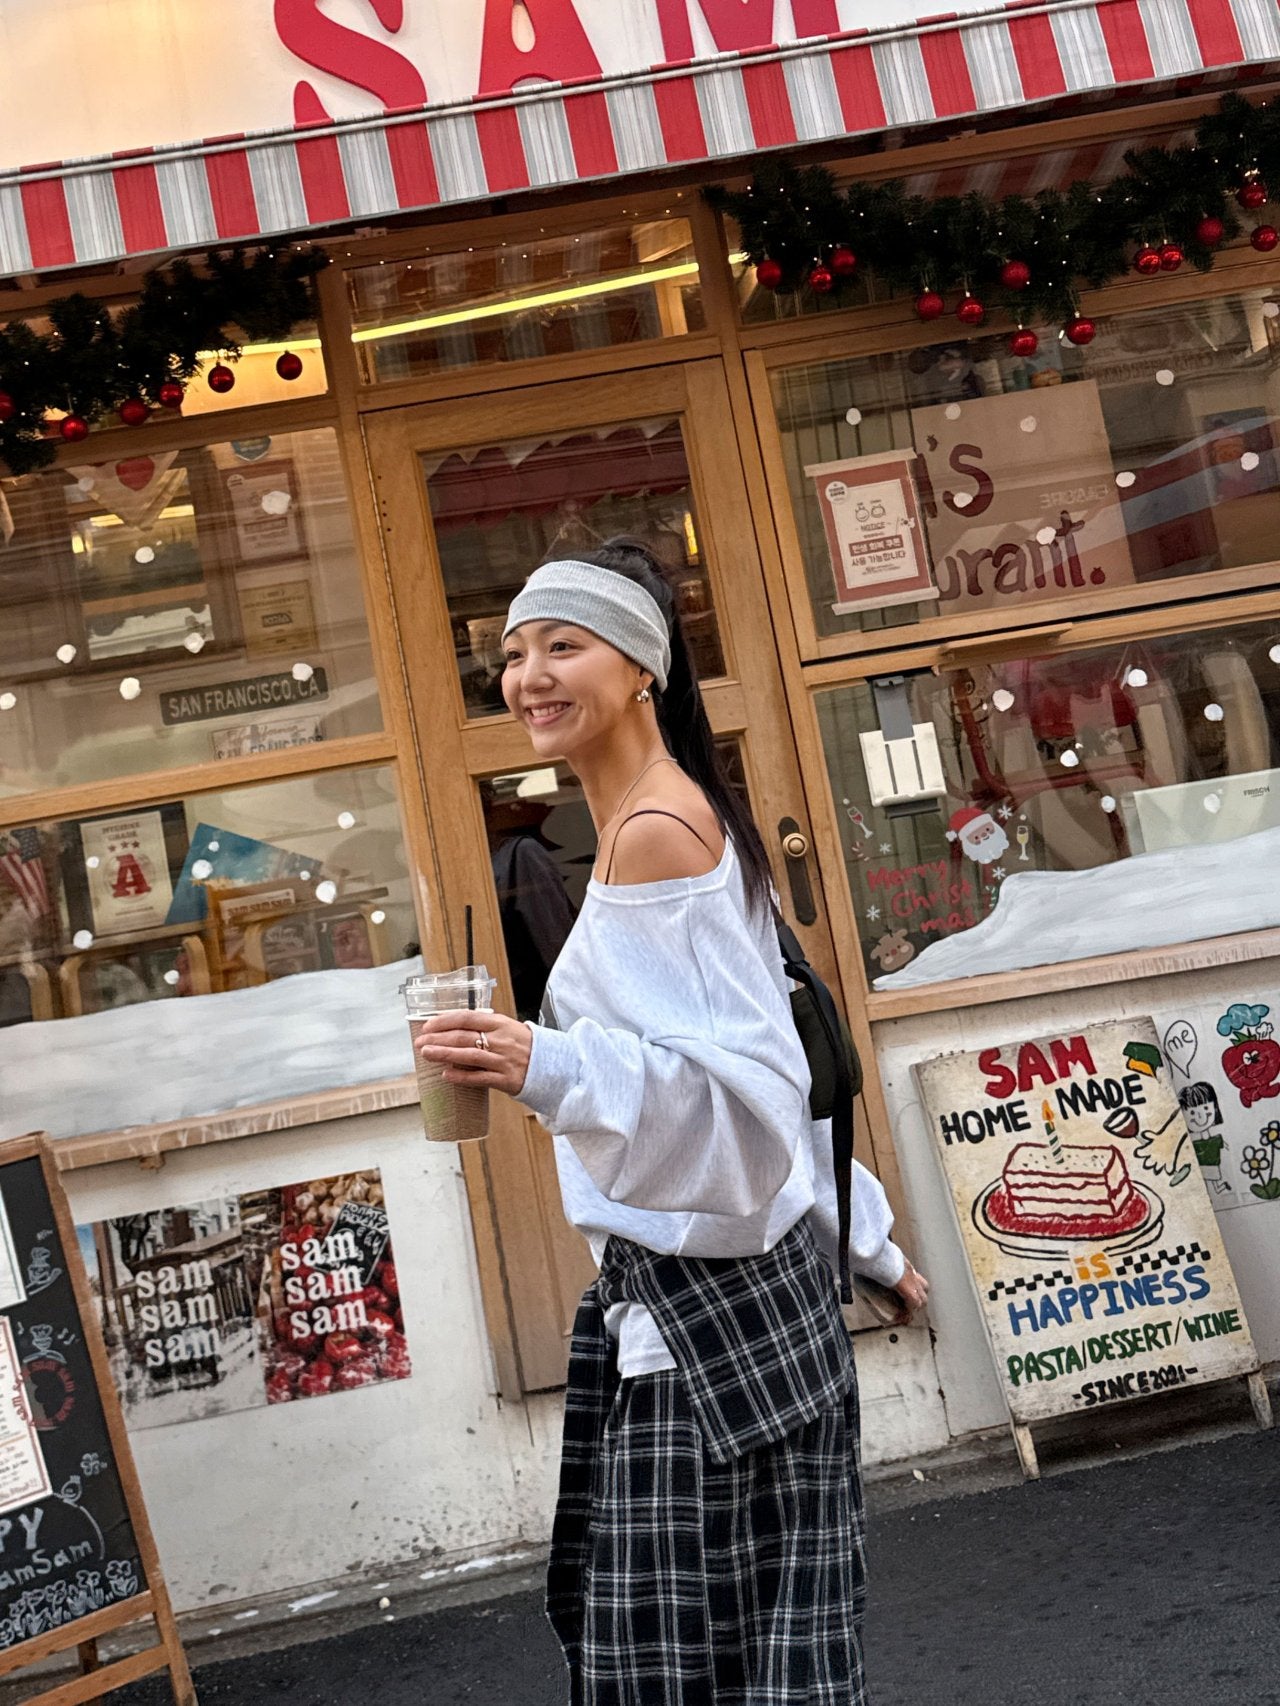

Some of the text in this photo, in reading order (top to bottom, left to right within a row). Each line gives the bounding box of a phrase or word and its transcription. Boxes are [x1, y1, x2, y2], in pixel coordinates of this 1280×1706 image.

[168, 693, 201, 719] SAN
[298, 676, 321, 697] CA
[111, 853, 152, 898] A
[866, 859, 947, 893] Merry
[1167, 1028, 1194, 1052] me
[977, 1035, 1098, 1099] SAM
[939, 1073, 1147, 1146] HOME MADE
[279, 1230, 361, 1270] sam
[135, 1259, 215, 1298] sam
[284, 1263, 365, 1305] sam
[140, 1293, 219, 1332] sam
[289, 1298, 370, 1339] sam
[1007, 1265, 1212, 1336] HAPPINESS
[144, 1327, 222, 1367] sam
